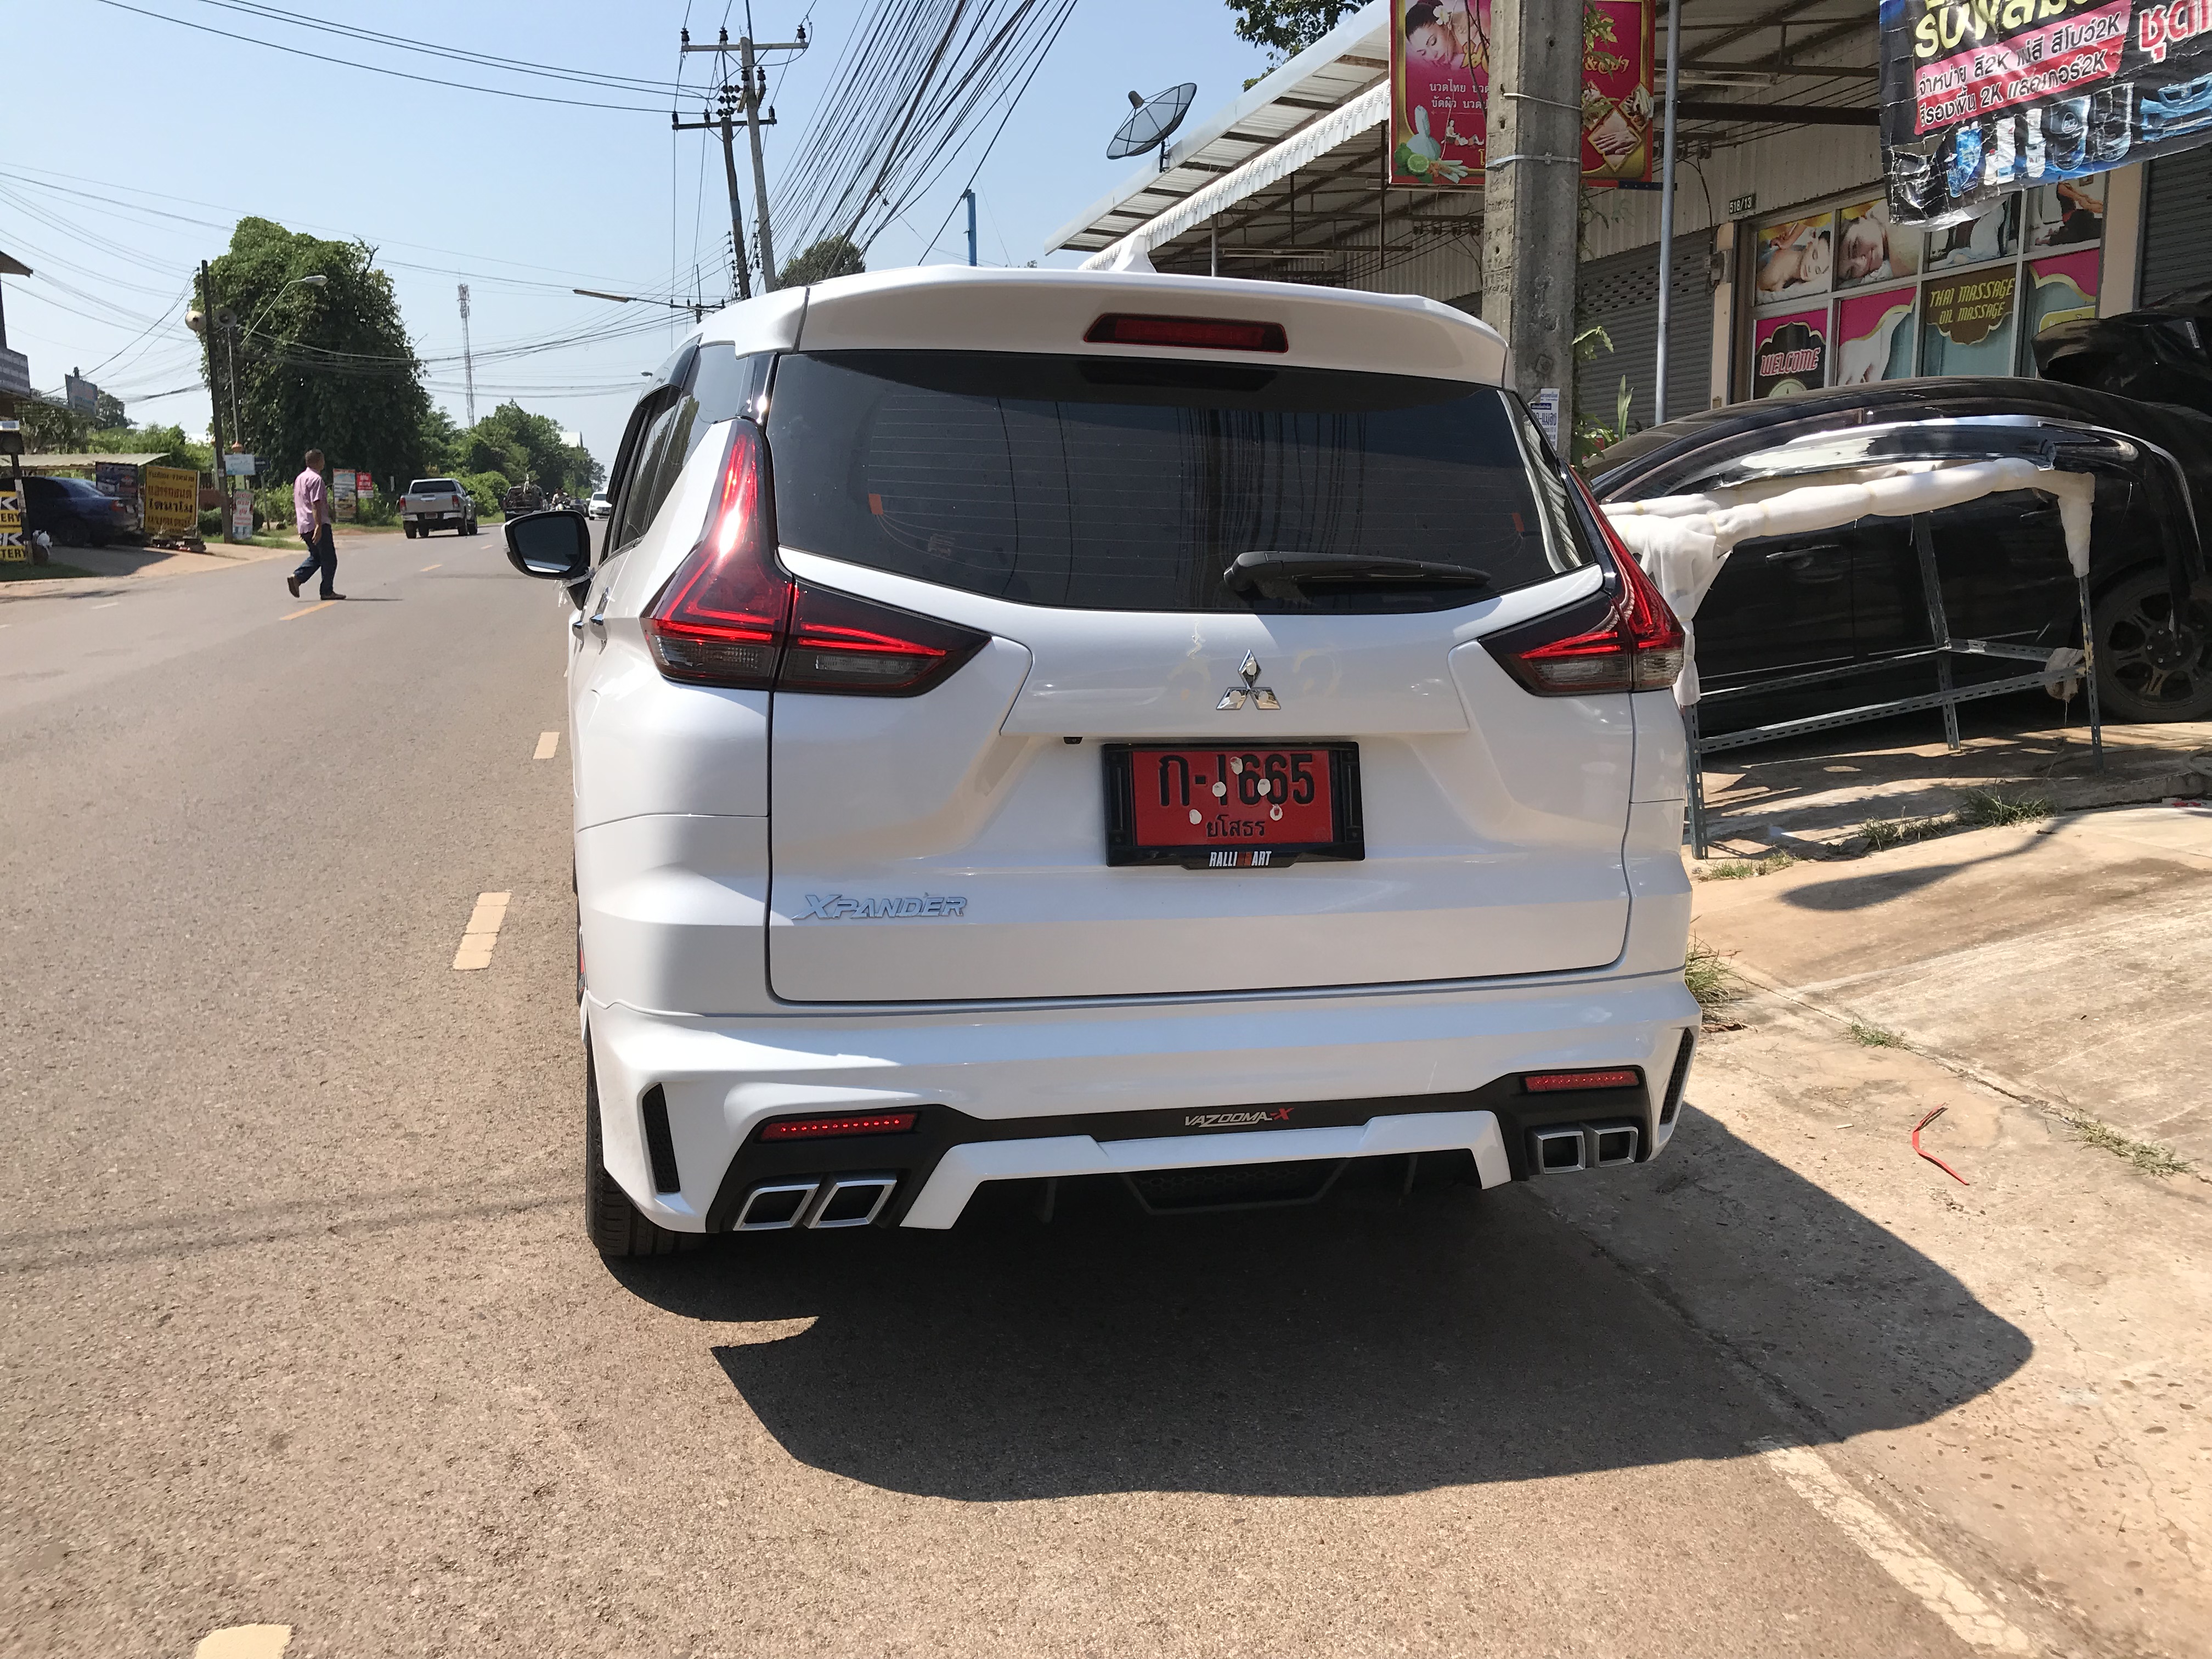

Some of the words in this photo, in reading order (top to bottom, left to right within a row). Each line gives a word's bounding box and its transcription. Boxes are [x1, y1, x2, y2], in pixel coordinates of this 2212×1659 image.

[1429, 79, 1466, 93] นวดไทย
[1919, 64, 1967, 97] จำหน่าย
[1431, 96, 1457, 108] ขัดผิว
[1980, 82, 2004, 108] 2K
[1729, 196, 1752, 213] 518/13
[1929, 287, 1955, 308] THAI
[1957, 278, 2016, 303] MASSAGE
[1939, 309, 1953, 325] OIL
[1957, 301, 2006, 321] MASSAGE
[1759, 347, 1821, 376] WELCOME
[1206, 814, 1266, 837] ยโสธร
[791, 894, 968, 920] XPANDER
